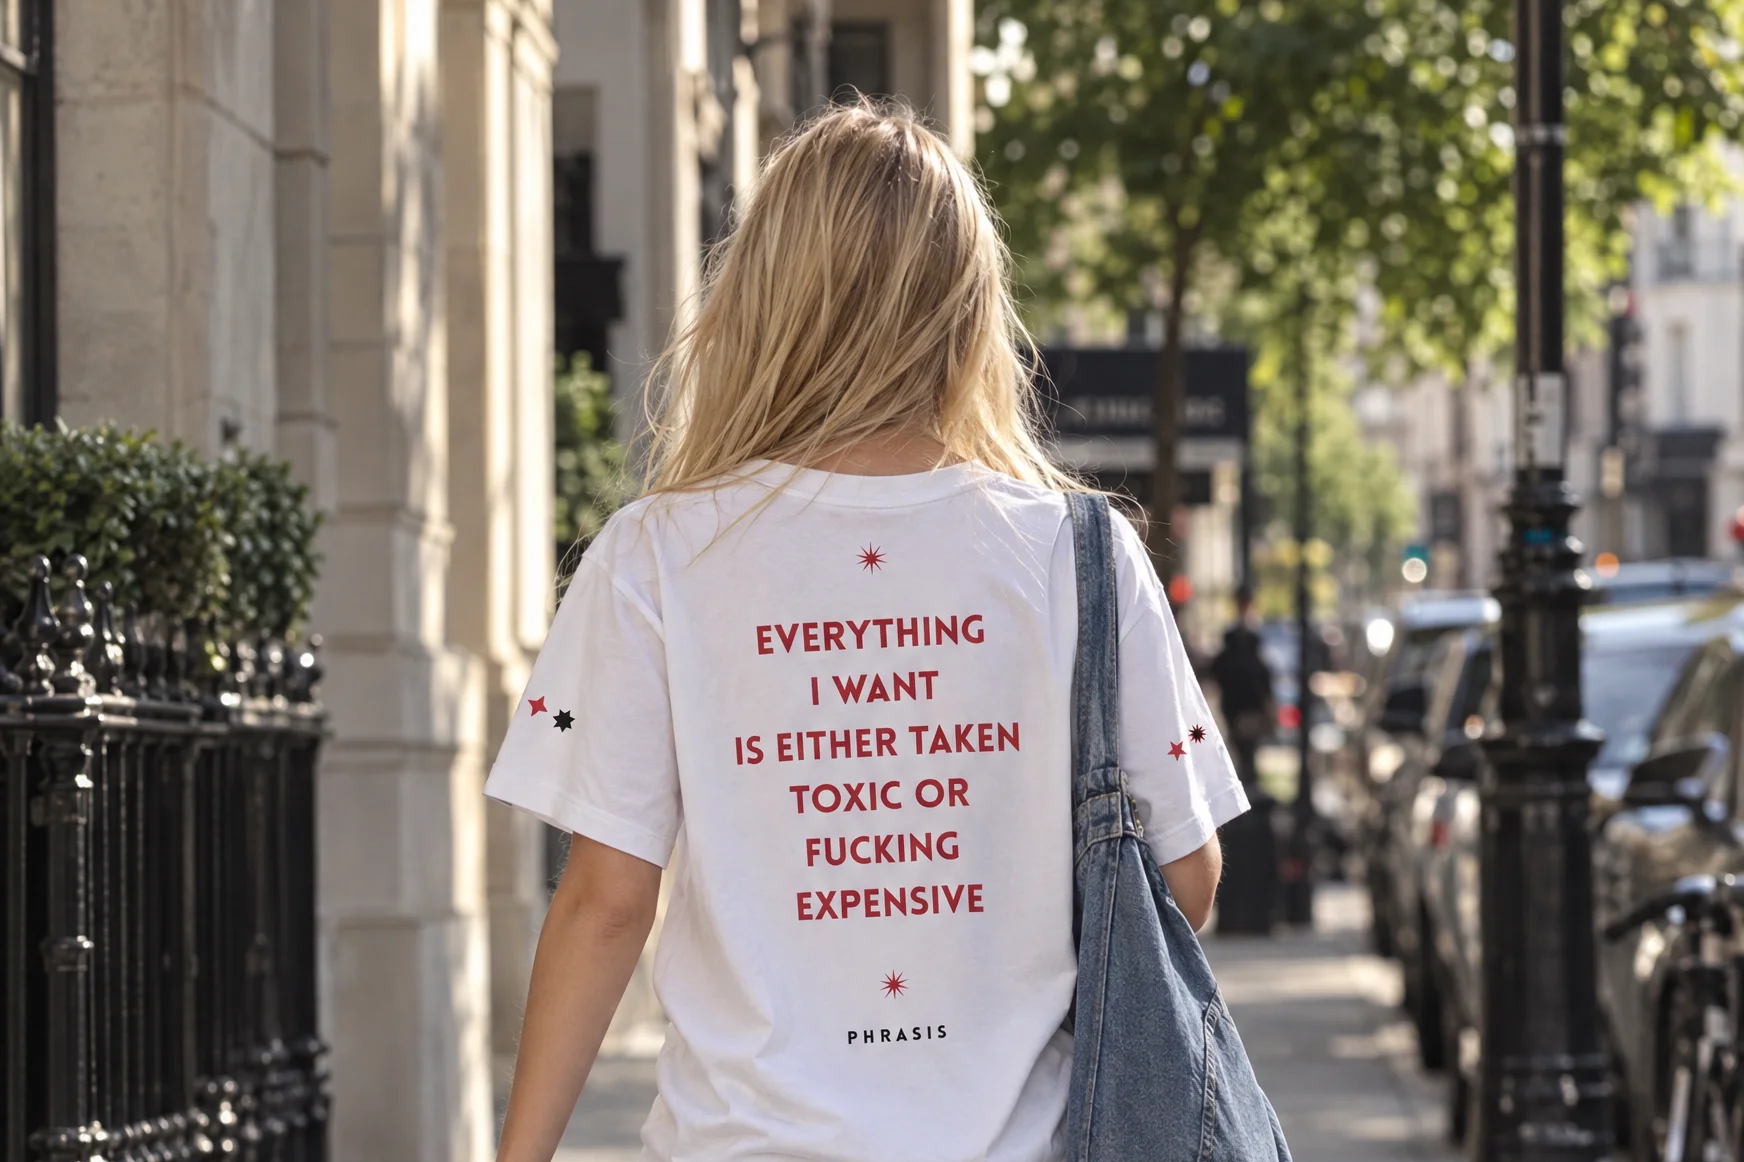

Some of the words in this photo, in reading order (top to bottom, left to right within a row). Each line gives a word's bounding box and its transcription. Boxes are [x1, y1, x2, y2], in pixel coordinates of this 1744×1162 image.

[756, 614, 985, 656] EVERYTHING
[810, 676, 819, 706] I
[832, 670, 939, 706] WANT
[735, 735, 765, 766] IS
[776, 728, 898, 763] EITHER
[908, 721, 1021, 756] TAKEN
[789, 780, 903, 815] TOXIC
[914, 777, 970, 810] OR
[805, 831, 960, 867] FUCKING
[796, 883, 985, 921] EXPENSIVE
[847, 1024, 947, 1045] PHRASIS
